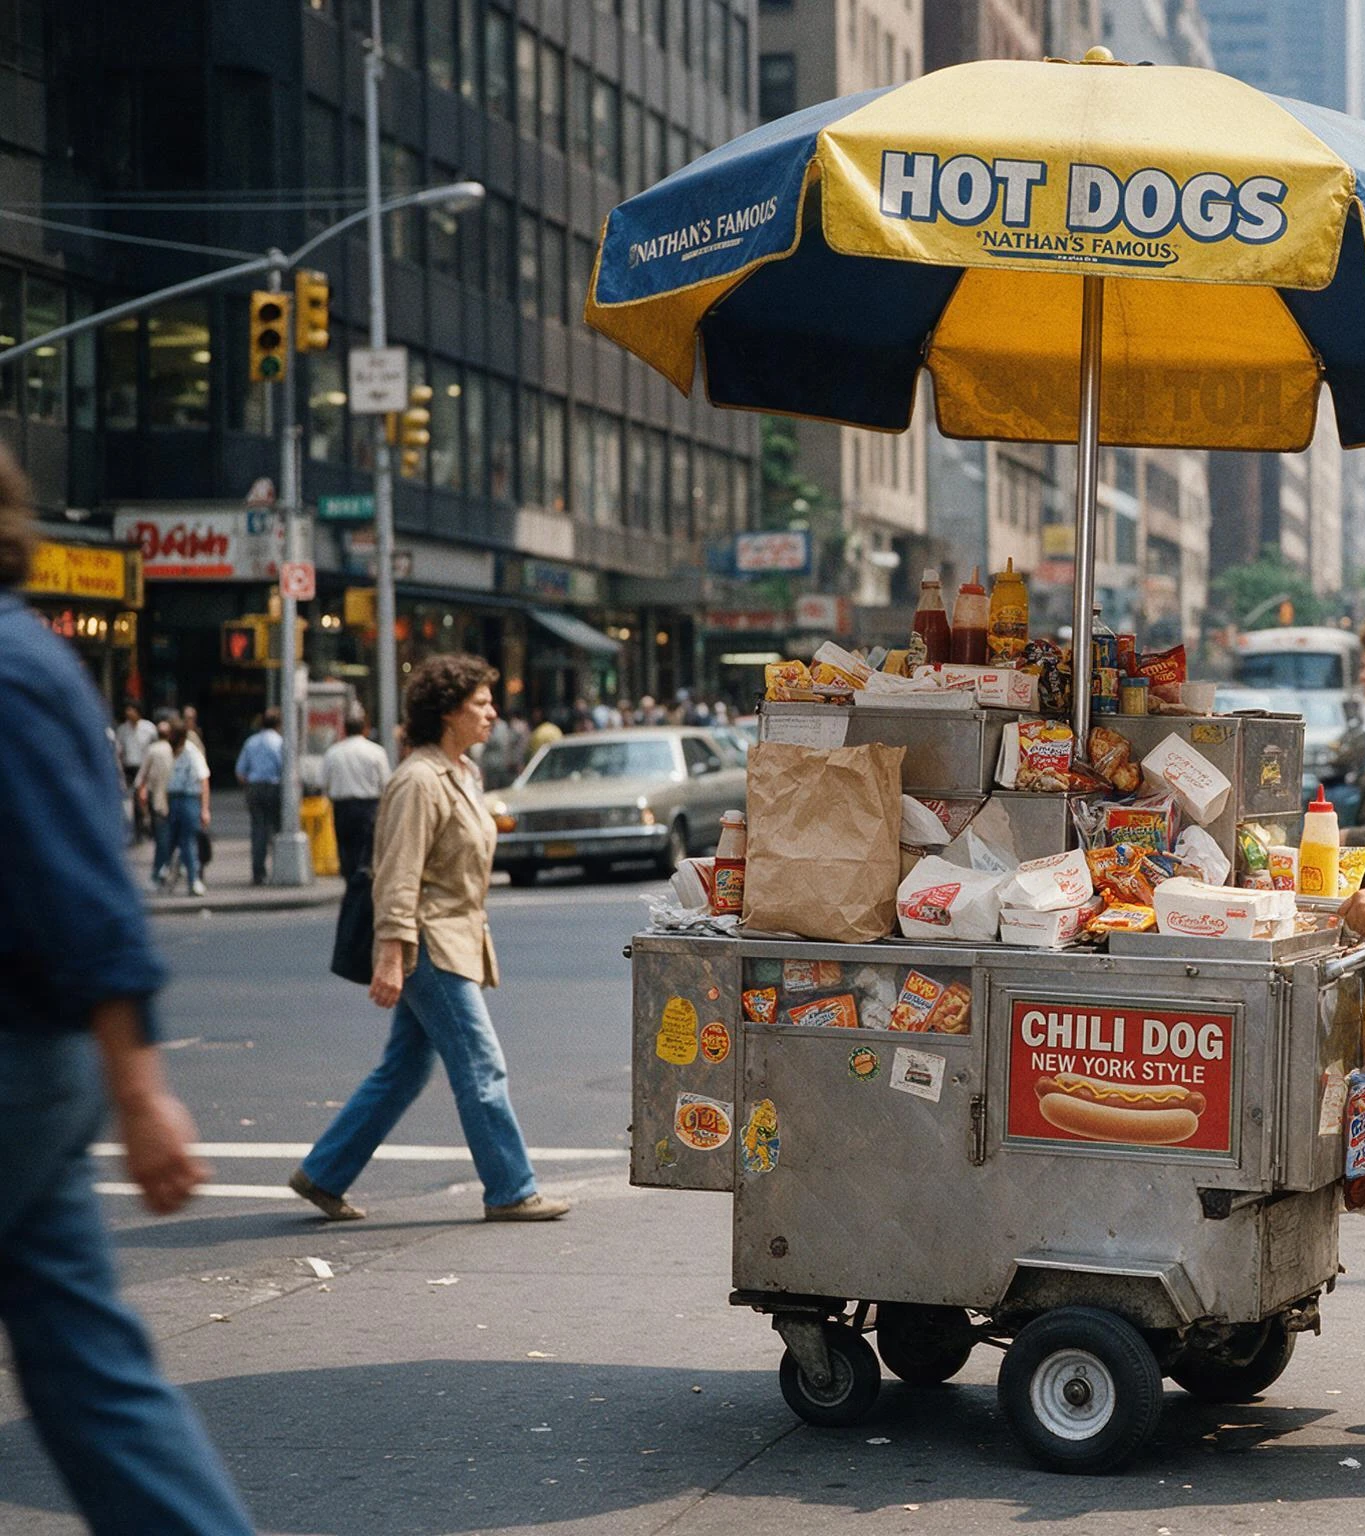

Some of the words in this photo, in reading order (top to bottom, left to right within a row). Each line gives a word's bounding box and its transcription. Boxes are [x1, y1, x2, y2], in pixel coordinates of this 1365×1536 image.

[717, 196, 778, 239] FAMOUS
[880, 150, 1047, 227] HOT
[1066, 162, 1289, 245] DOGS
[1092, 238, 1172, 259] FAMOUS
[1021, 1010, 1126, 1053] CHILI
[1142, 1019, 1224, 1060] DOG
[1031, 1052, 1077, 1073] NEW
[1082, 1056, 1136, 1079] YORK
[1142, 1062, 1206, 1083] STYLE
